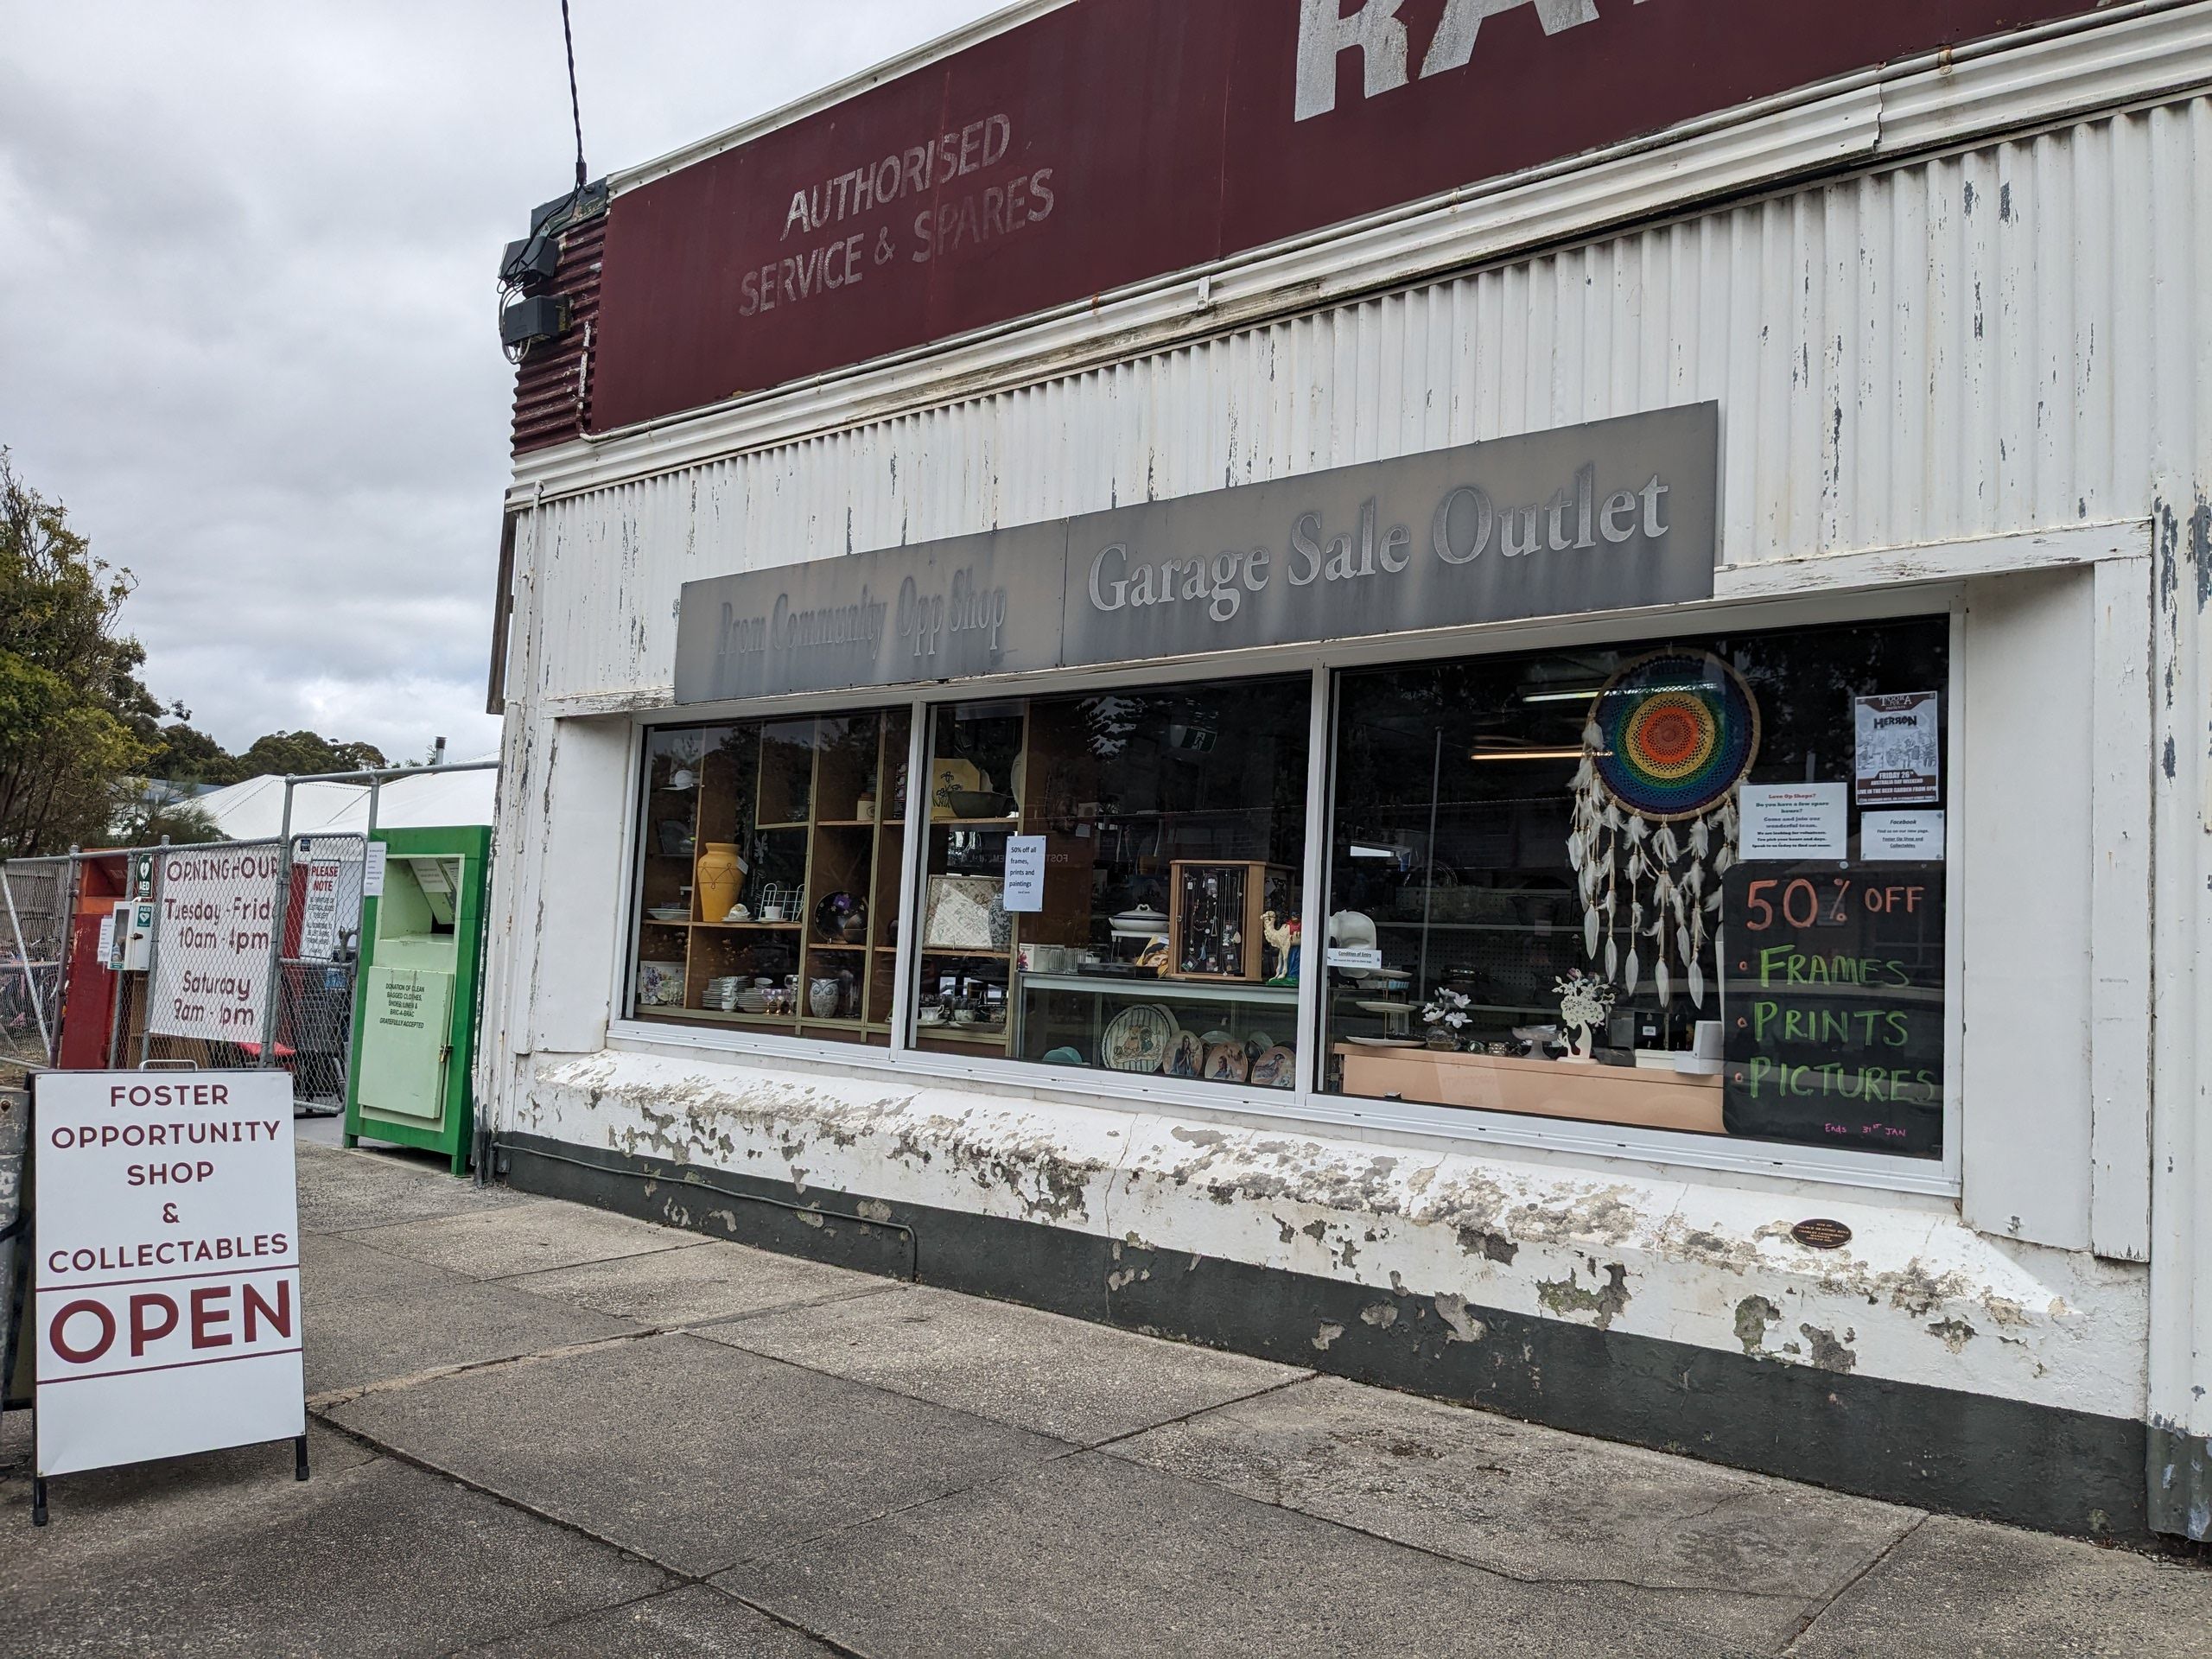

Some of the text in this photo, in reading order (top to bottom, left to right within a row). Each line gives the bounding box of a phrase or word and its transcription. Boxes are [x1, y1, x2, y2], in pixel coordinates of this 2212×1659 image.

[779, 113, 1011, 241] AUTHORISED
[739, 168, 1055, 317] SERVICE & SPARES
[1088, 462, 1669, 622] Garage Sale Outlet
[718, 563, 1007, 660] Prom Community Opp Shop
[1874, 715, 1917, 729] HERRON
[232, 856, 278, 879] HOUR
[311, 866, 339, 877] PLEASE
[139, 881, 150, 891] AED
[313, 881, 333, 891] NOTE
[164, 898, 221, 926] Tuesday
[1746, 877, 1925, 931] 50% OFF
[179, 926, 216, 949] 10am
[1760, 944, 1910, 988] FRAMES
[174, 998, 205, 1022] 9am
[380, 1017, 404, 1026] GRATEFULLY
[390, 1009, 415, 1017] BRIC-A-BRAC
[1754, 1001, 1909, 1046] PRINTS
[1749, 1056, 1936, 1102] PICTURES
[111, 1084, 229, 1107] FOSTER
[51, 1120, 281, 1148] OPPORTUNITY
[1825, 1123, 1847, 1134] Ends
[1885, 1127, 1906, 1137] JAN
[127, 1161, 214, 1185] SHOP
[162, 1202, 180, 1224] &
[49, 1233, 289, 1274] COLLECTABLES
[49, 1279, 291, 1364] OPEN
